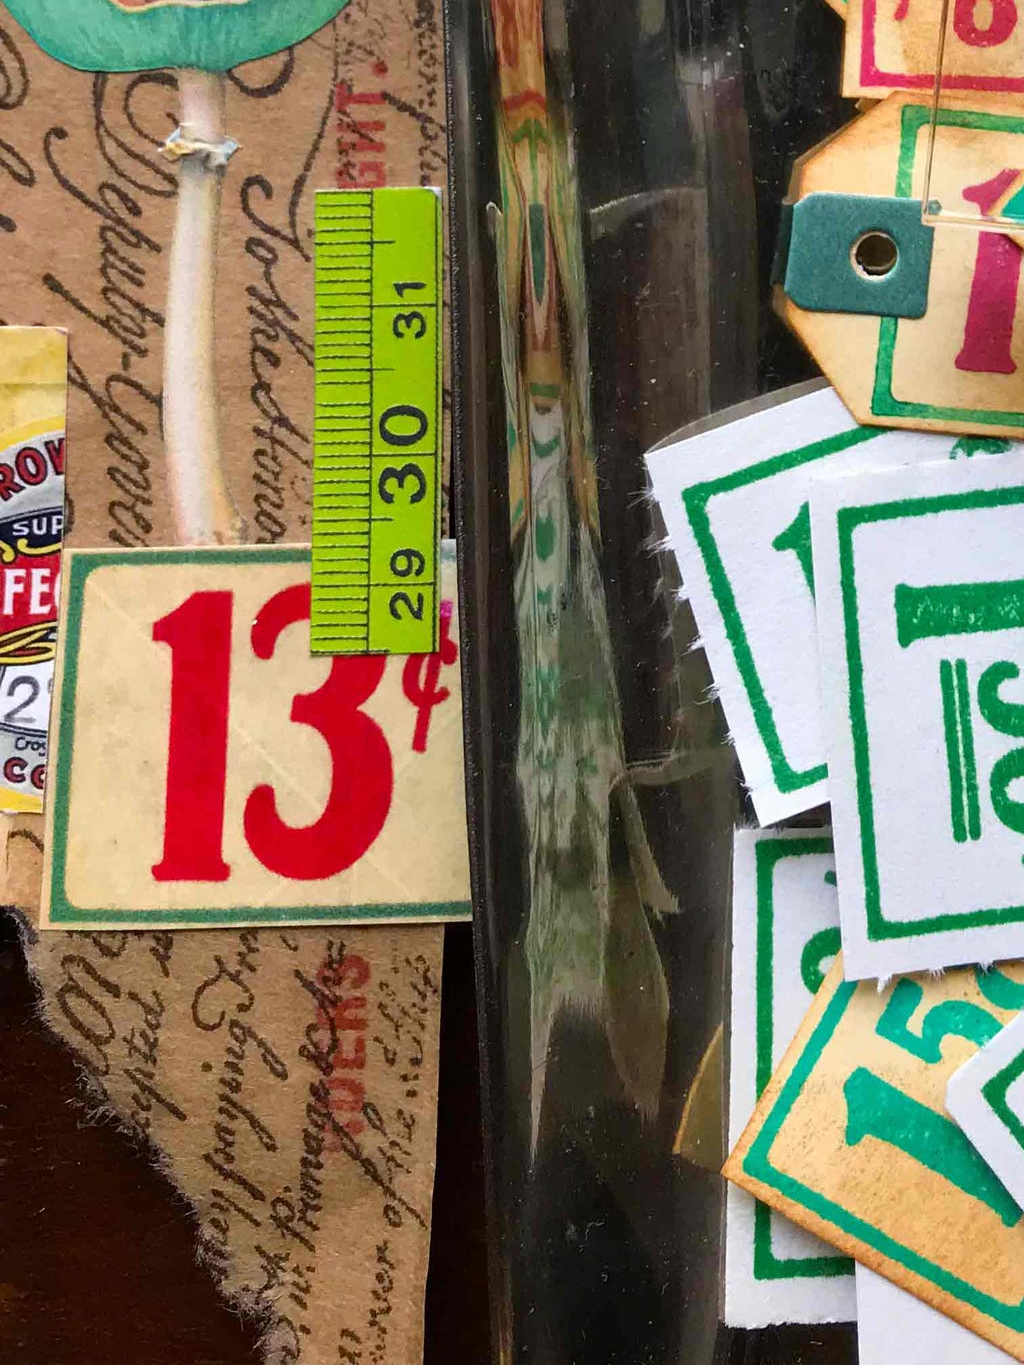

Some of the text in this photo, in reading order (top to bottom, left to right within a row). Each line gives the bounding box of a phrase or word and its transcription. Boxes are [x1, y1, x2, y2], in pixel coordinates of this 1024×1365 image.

[392, 282, 426, 339] 31
[378, 405, 428, 505] 30
[3, 567, 61, 615] FE
[388, 547, 426, 621] 29
[151, 580, 459, 884] 13¢
